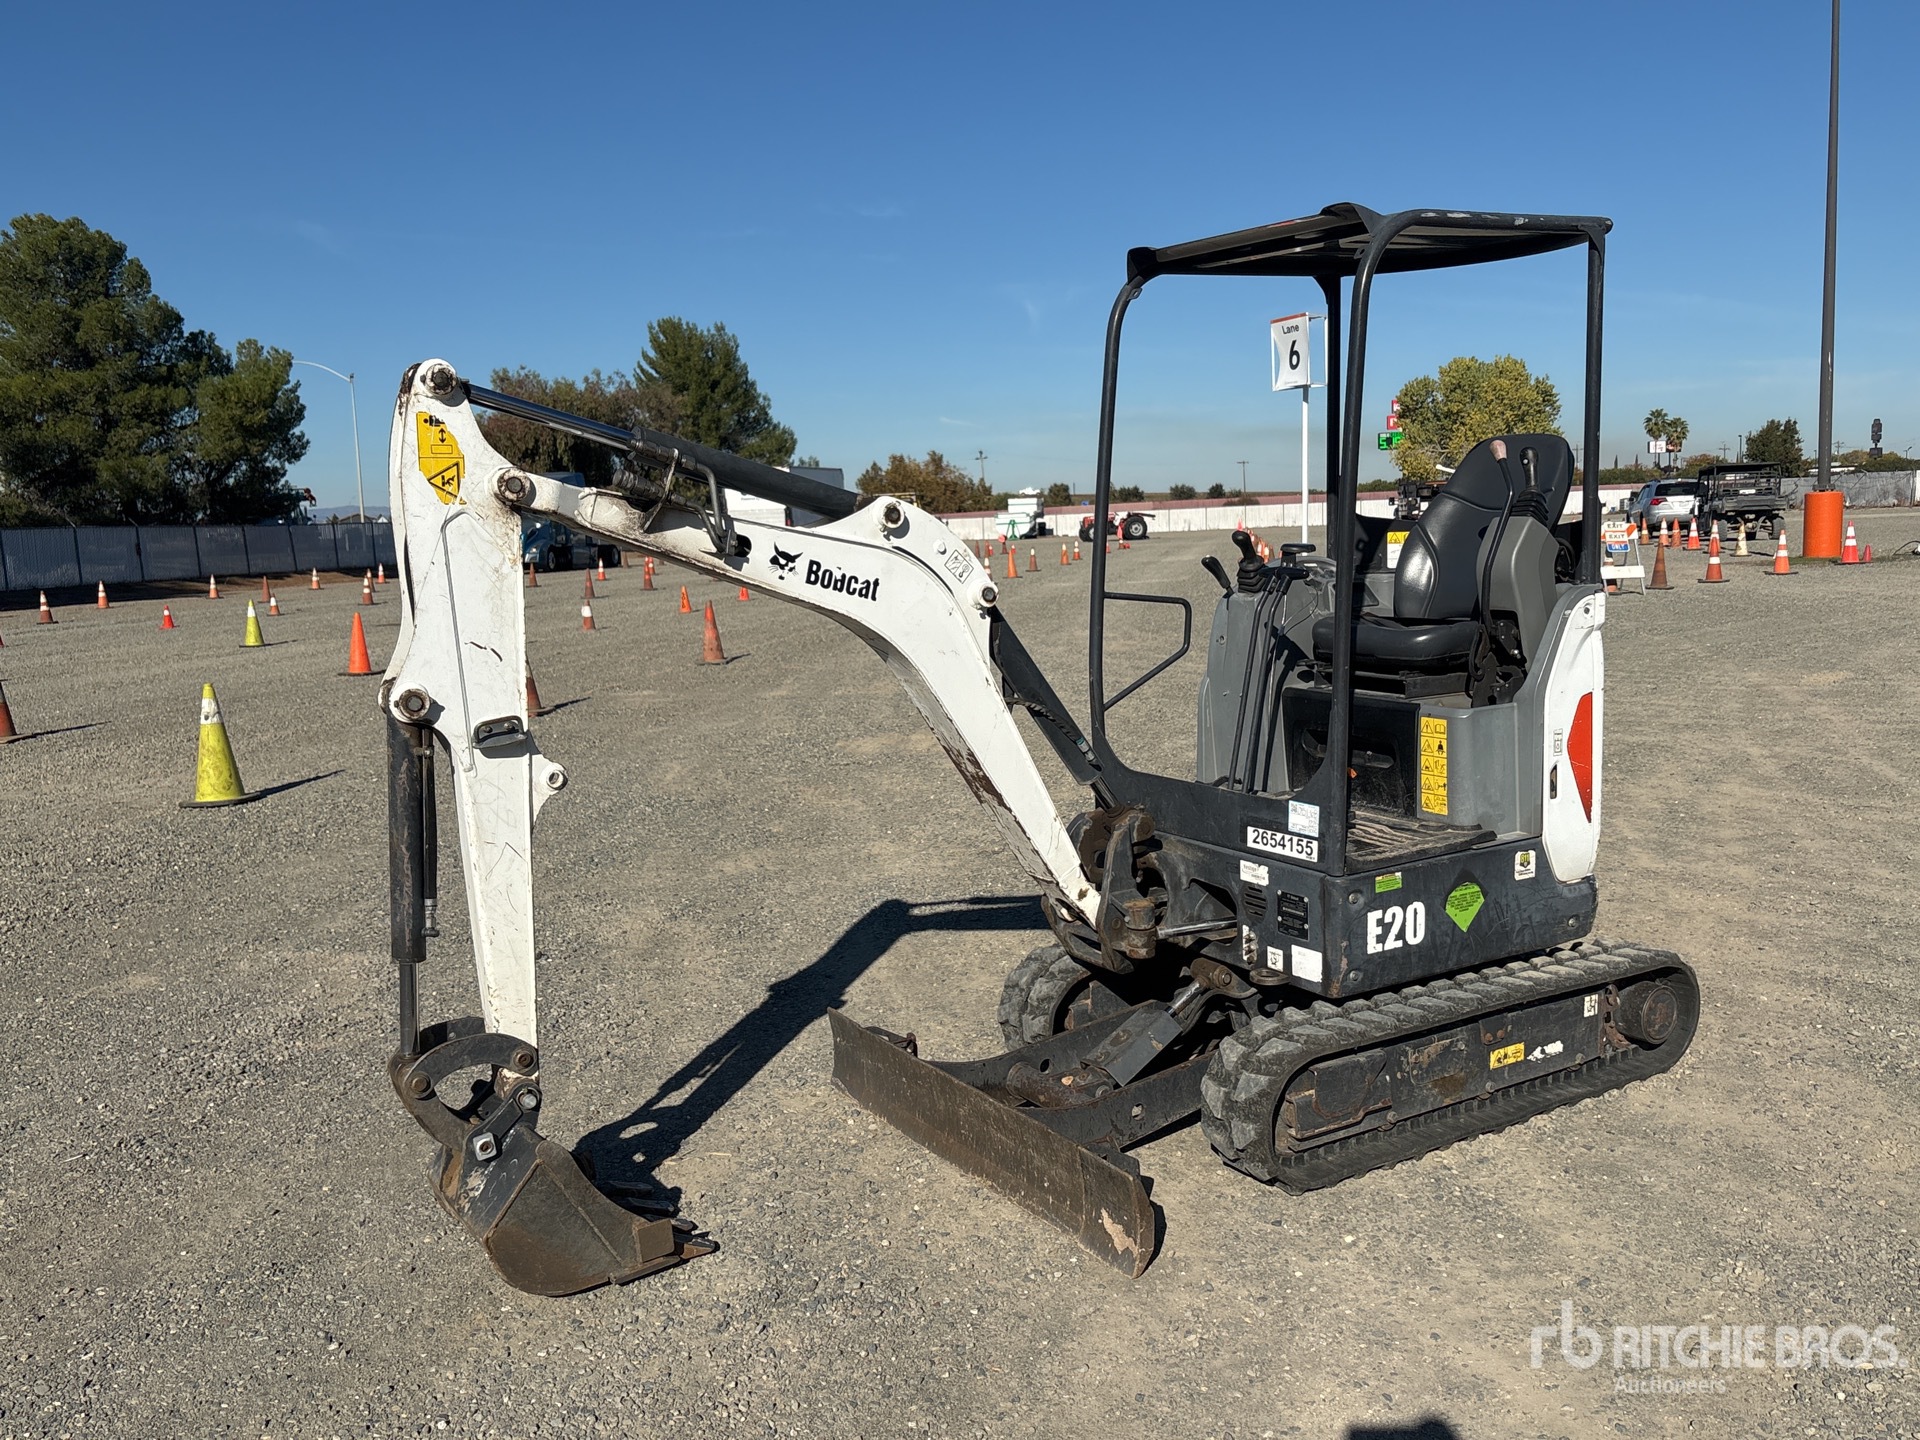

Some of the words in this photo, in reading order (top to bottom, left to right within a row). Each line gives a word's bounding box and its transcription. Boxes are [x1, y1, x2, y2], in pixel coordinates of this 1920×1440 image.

[1281, 324, 1300, 335] Lane
[1289, 339, 1301, 371] 6
[805, 559, 880, 602] Bobcat
[1252, 828, 1314, 856] 2654155
[1366, 901, 1426, 955] E20
